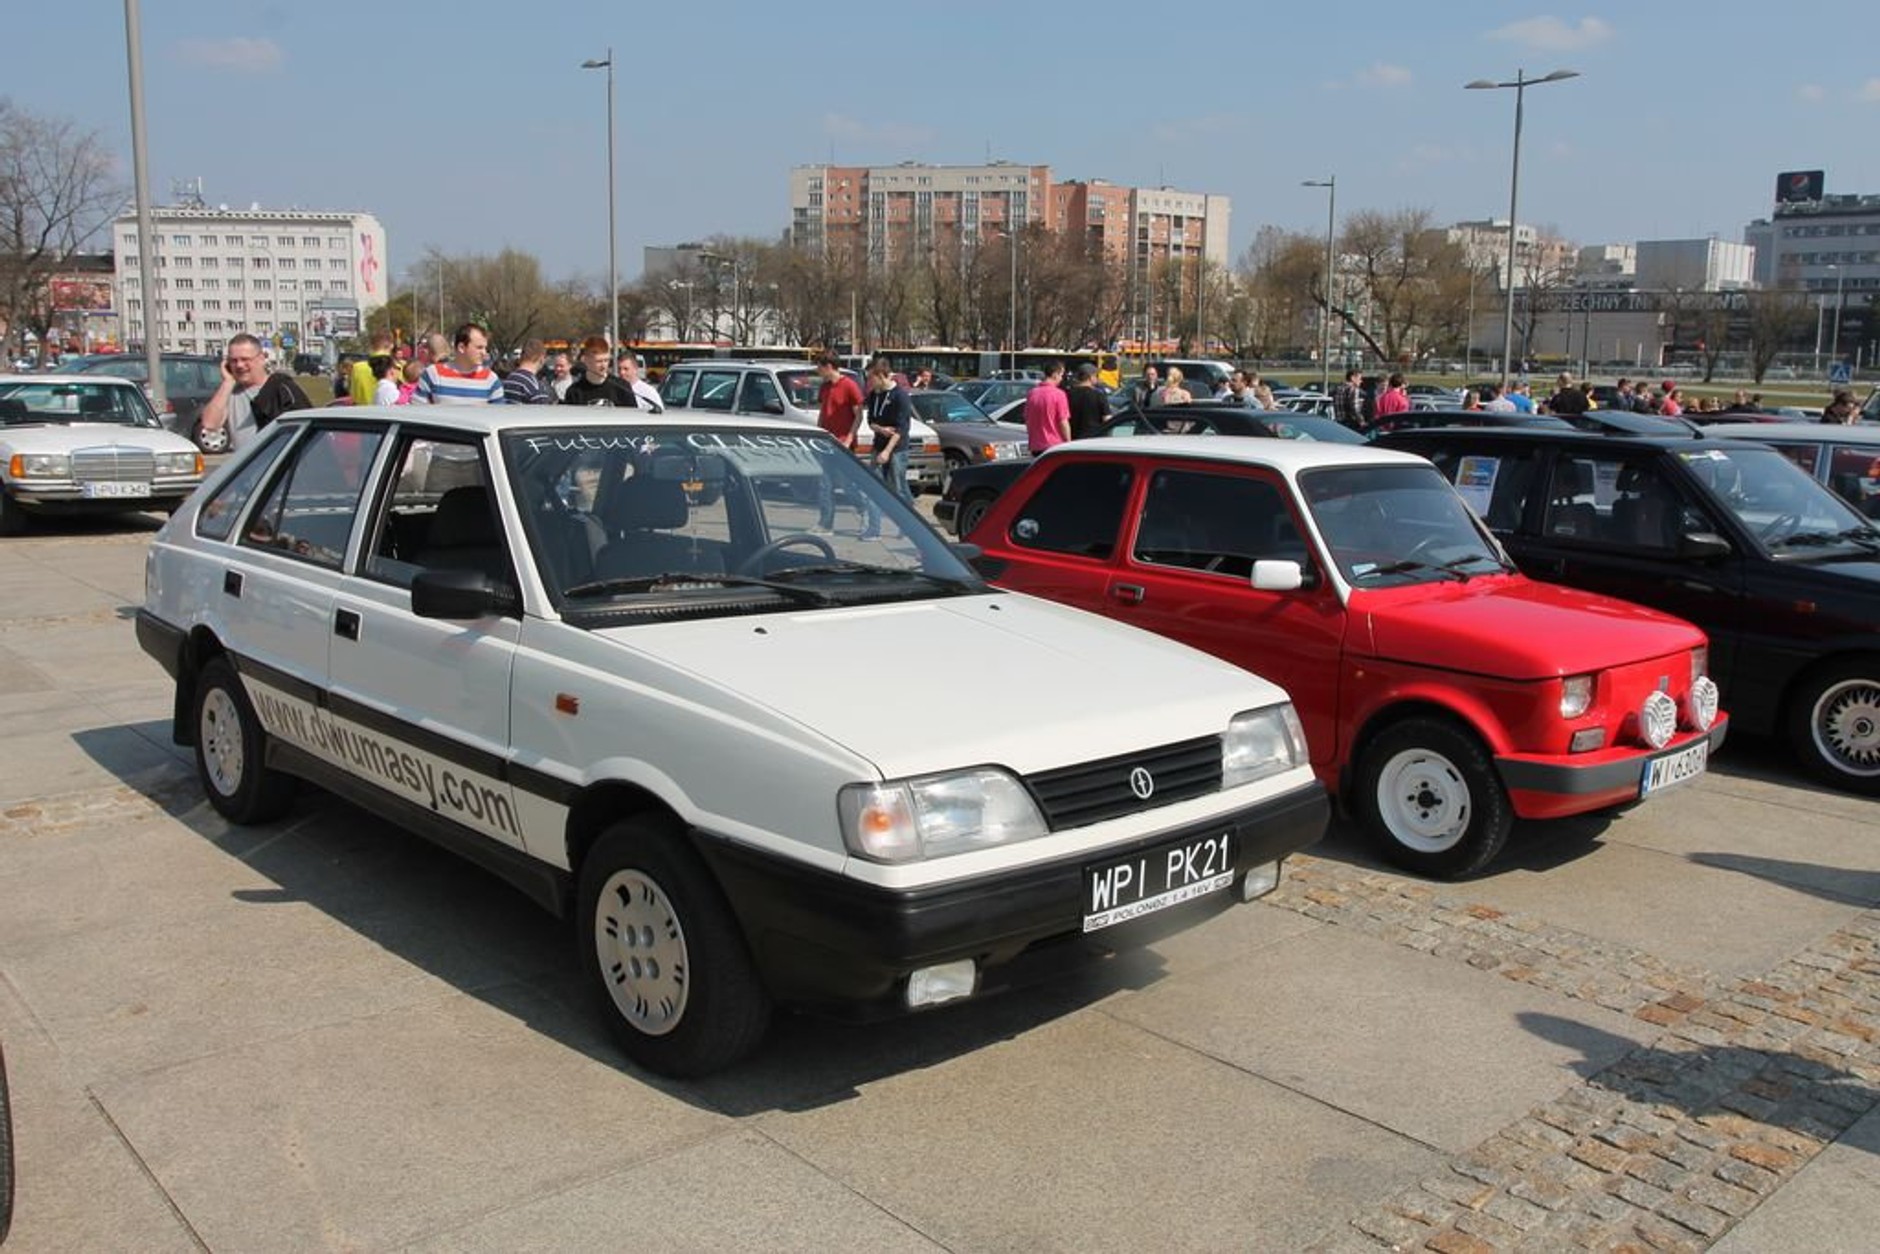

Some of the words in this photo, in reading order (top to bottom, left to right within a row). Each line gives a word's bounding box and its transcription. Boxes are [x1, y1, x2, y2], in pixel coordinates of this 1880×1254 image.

[686, 433, 834, 455] CLASSIC
[253, 688, 518, 836] www.dwumasy.com
[1092, 859, 1146, 912] WPI
[1166, 833, 1229, 890] PK21
